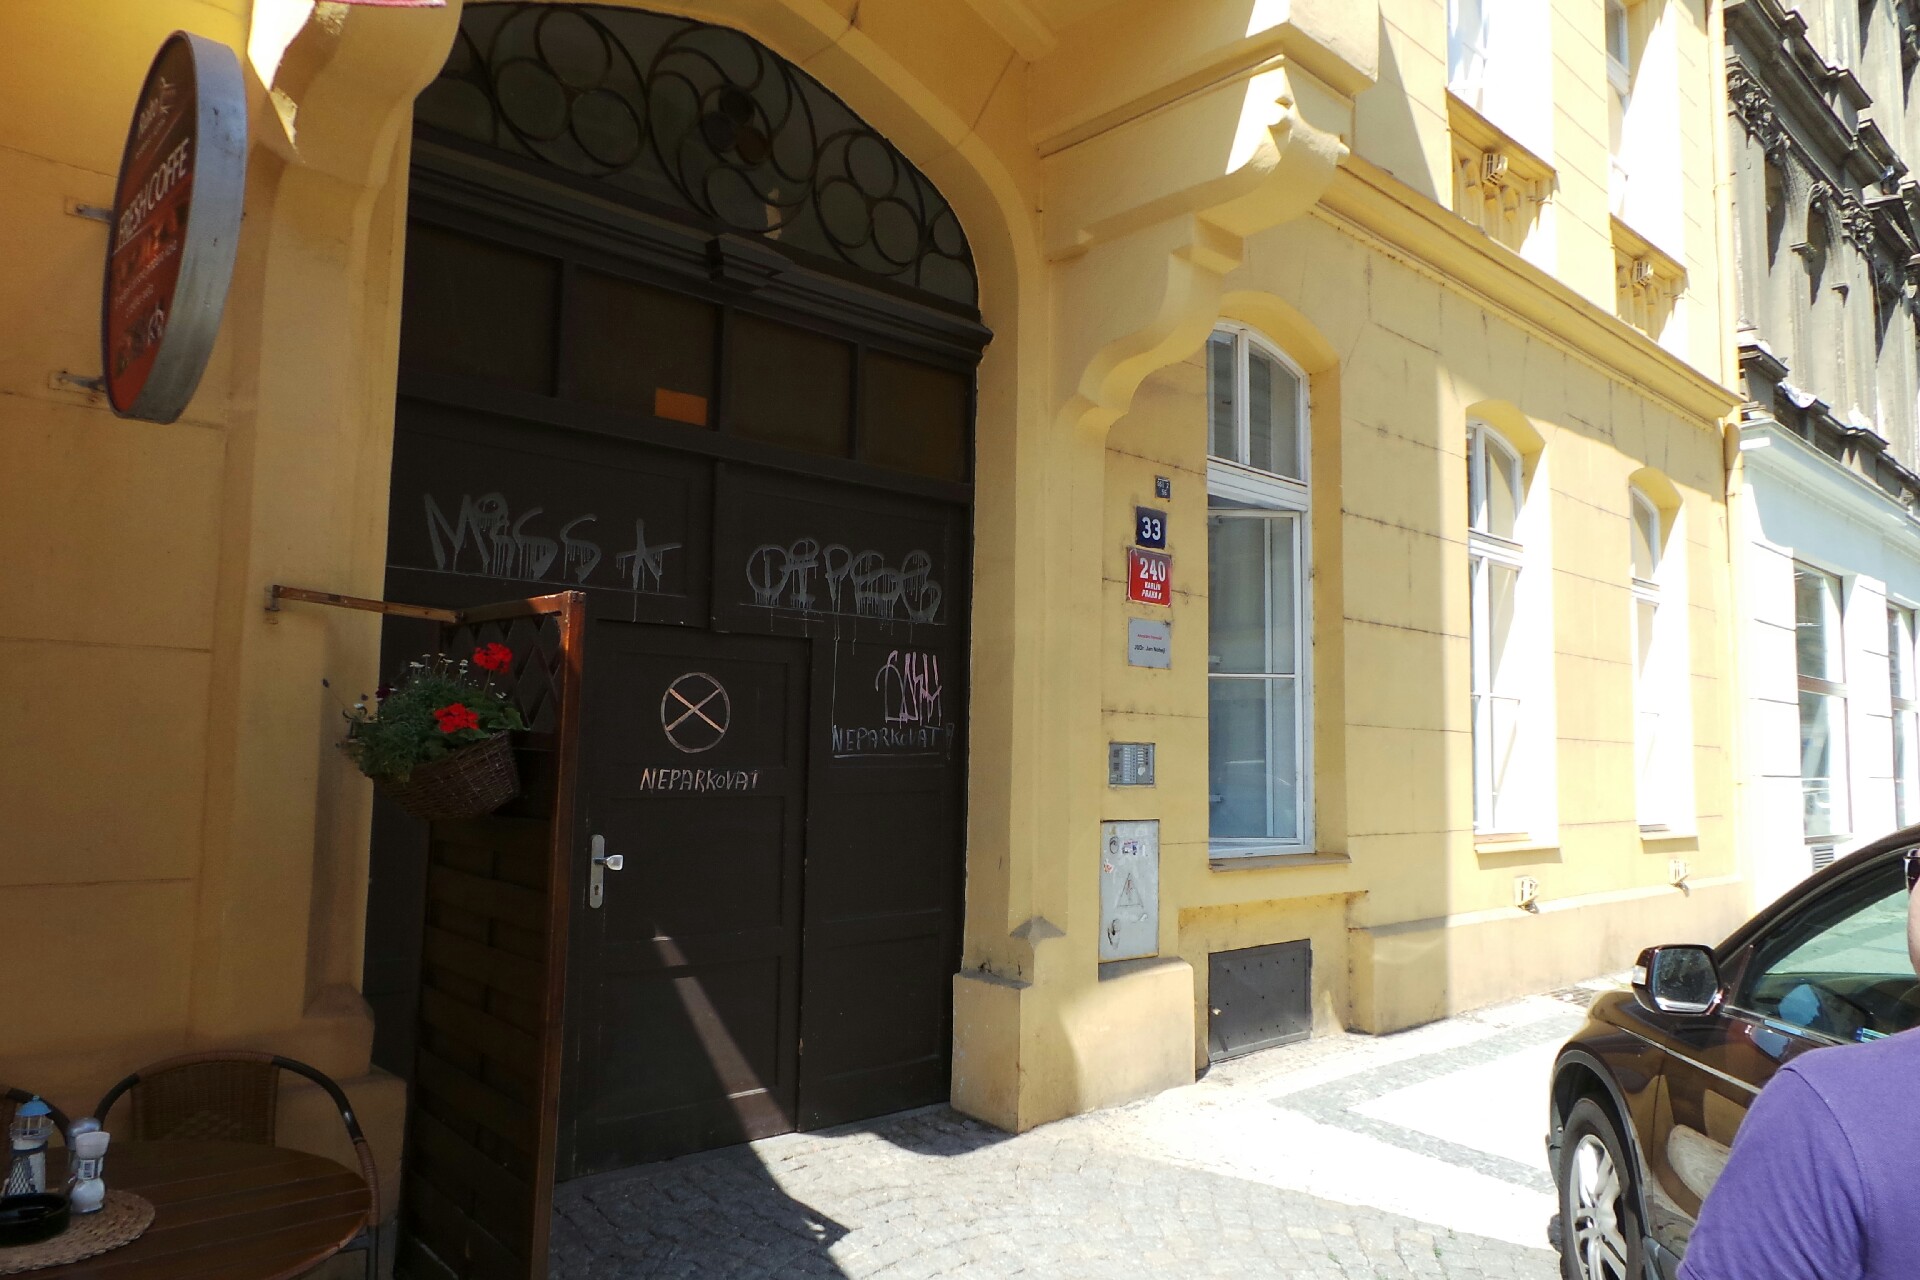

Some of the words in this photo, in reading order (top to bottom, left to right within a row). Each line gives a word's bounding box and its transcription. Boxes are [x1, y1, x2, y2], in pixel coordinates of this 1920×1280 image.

[1141, 516, 1161, 540] 33
[1139, 557, 1166, 582] 240
[1141, 588, 1158, 599] PRAHA
